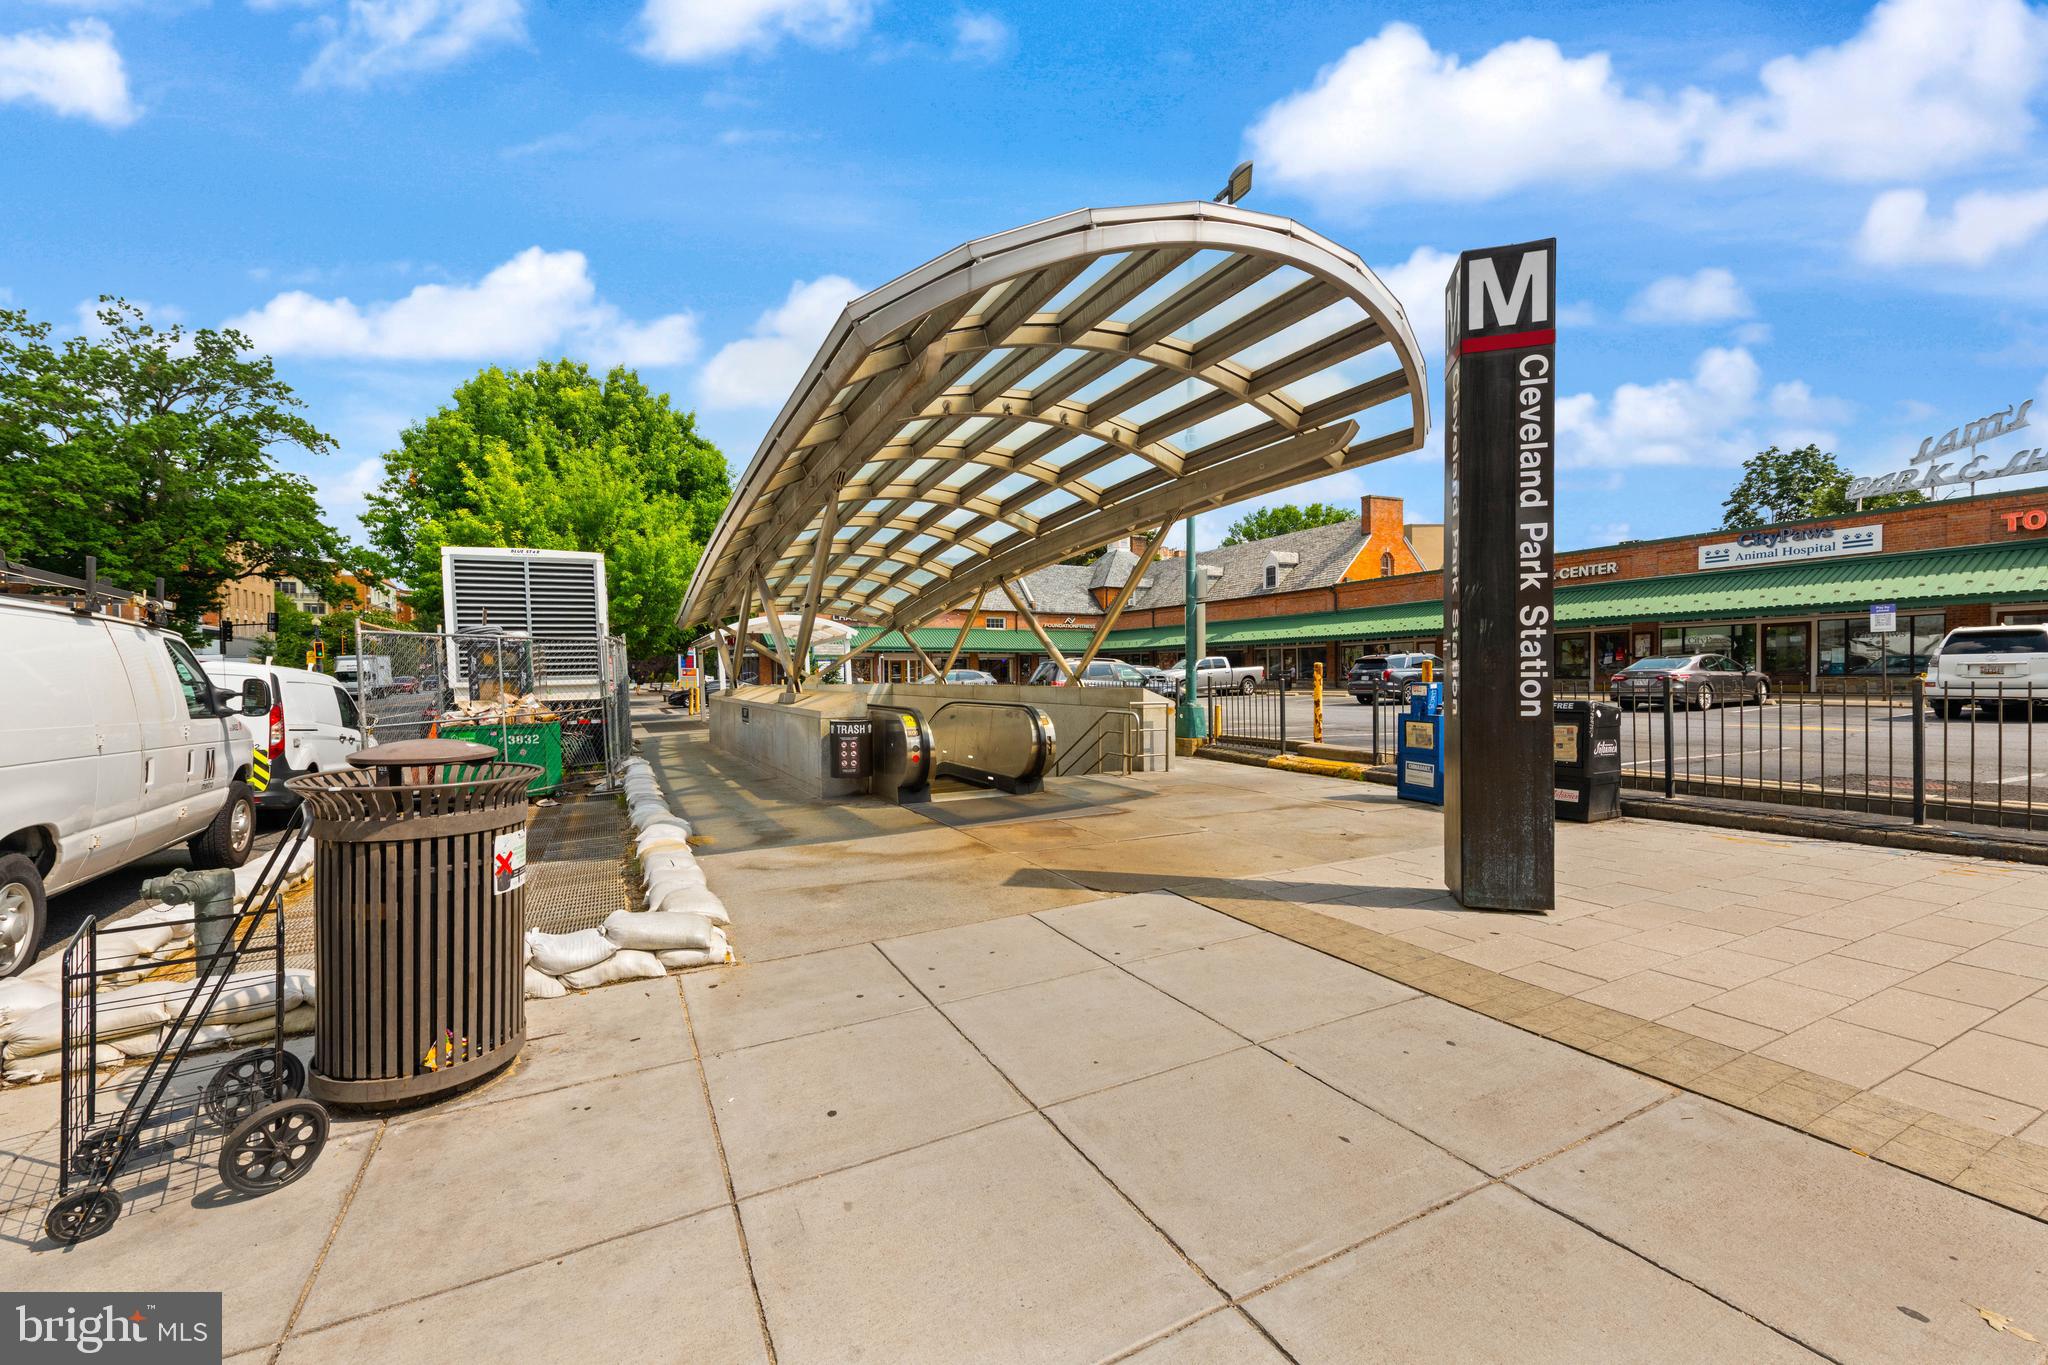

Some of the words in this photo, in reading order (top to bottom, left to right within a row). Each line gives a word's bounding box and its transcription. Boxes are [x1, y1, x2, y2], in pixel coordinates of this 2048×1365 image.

[1469, 249, 1548, 331] M
[1452, 368, 1460, 516] Cleveland
[1519, 354, 1549, 508] Cleveland
[1845, 462, 1955, 500] PARK
[1735, 547, 1778, 562] Animal
[1782, 542, 1836, 558] Hospital
[2001, 509, 2047, 532] TO
[1452, 528, 1460, 594] Park
[1519, 523, 1549, 591] Park
[1559, 562, 1617, 579] CENTER
[1452, 609, 1460, 716] Station
[1519, 605, 1549, 717] Station
[837, 724, 865, 734] TRASH
